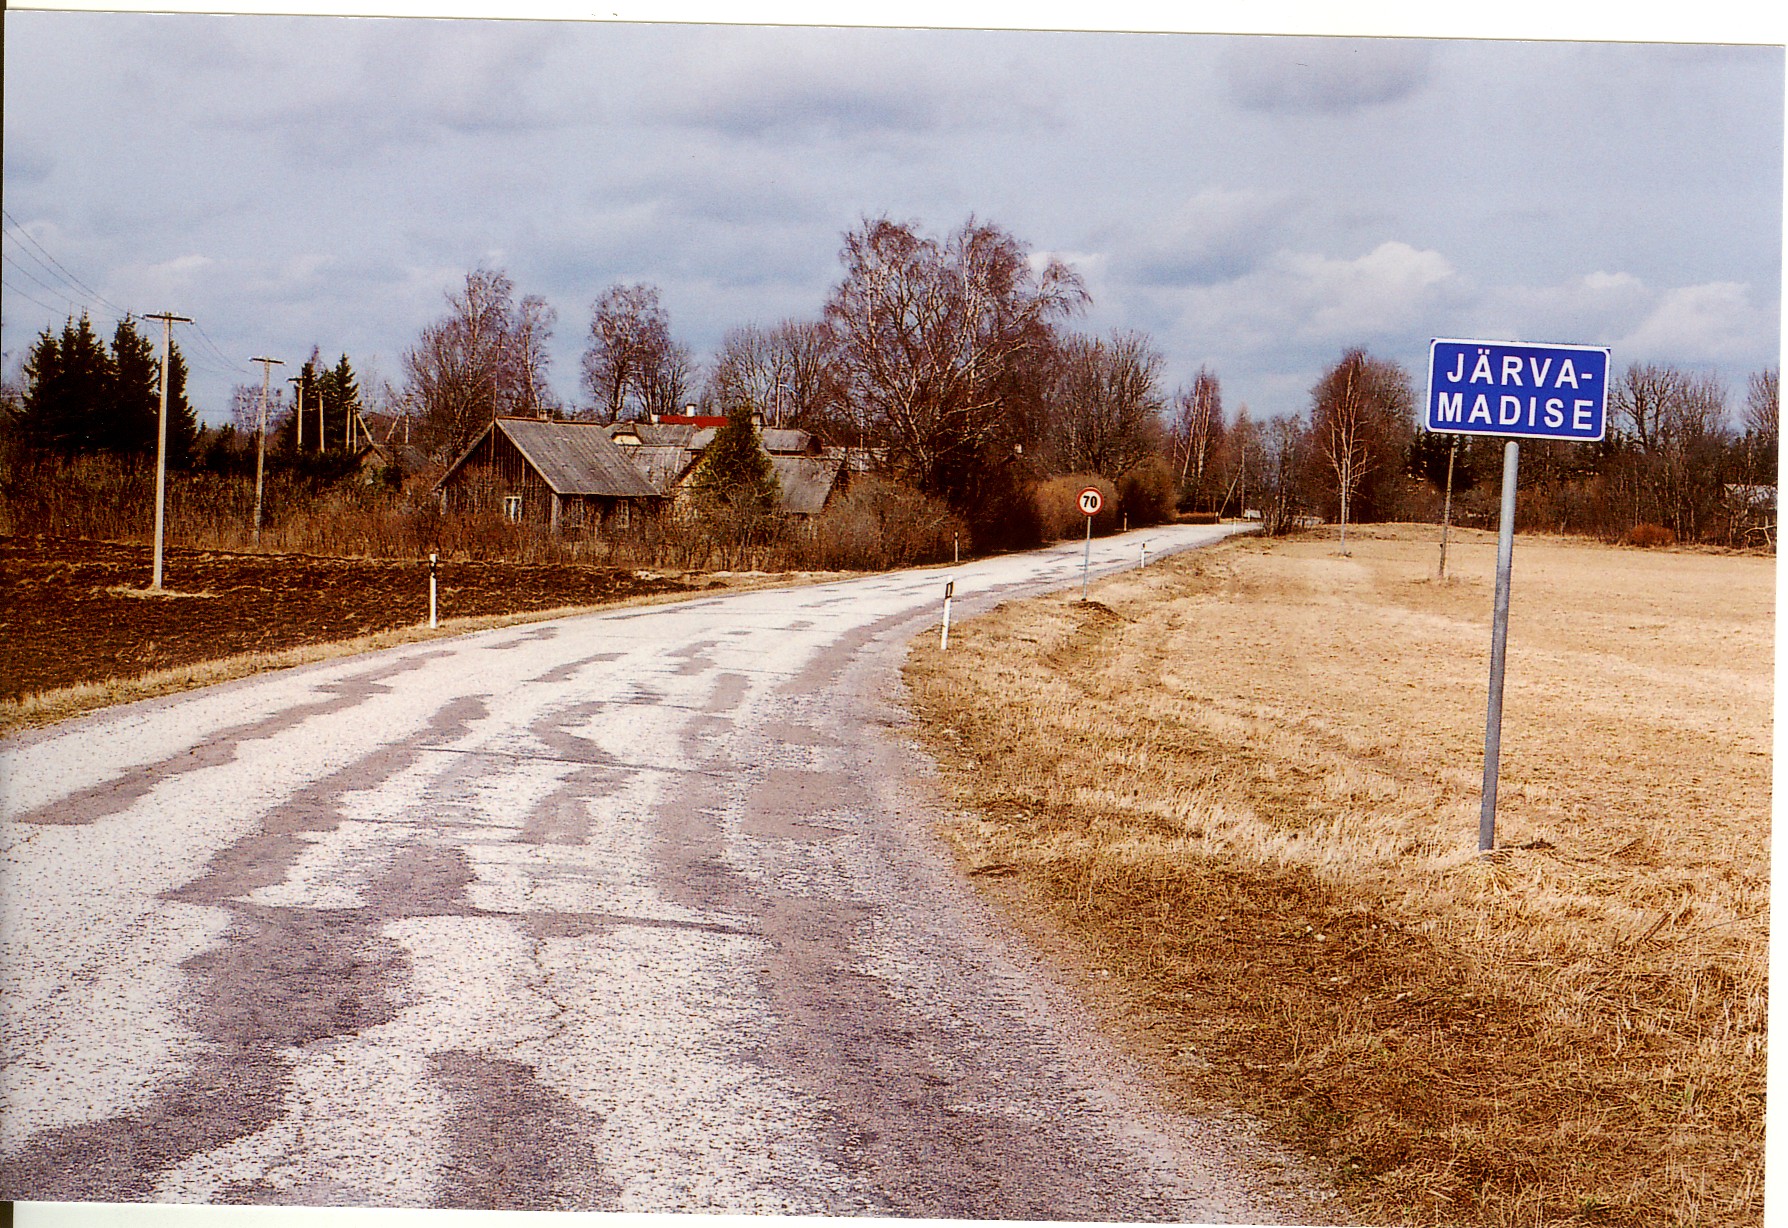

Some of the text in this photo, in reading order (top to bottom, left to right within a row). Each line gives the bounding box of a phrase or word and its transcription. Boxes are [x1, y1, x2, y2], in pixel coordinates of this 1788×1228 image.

[1446, 348, 1593, 389] JÄRVA-
[1437, 392, 1594, 430] MADISE
[1083, 495, 1097, 509] 70
